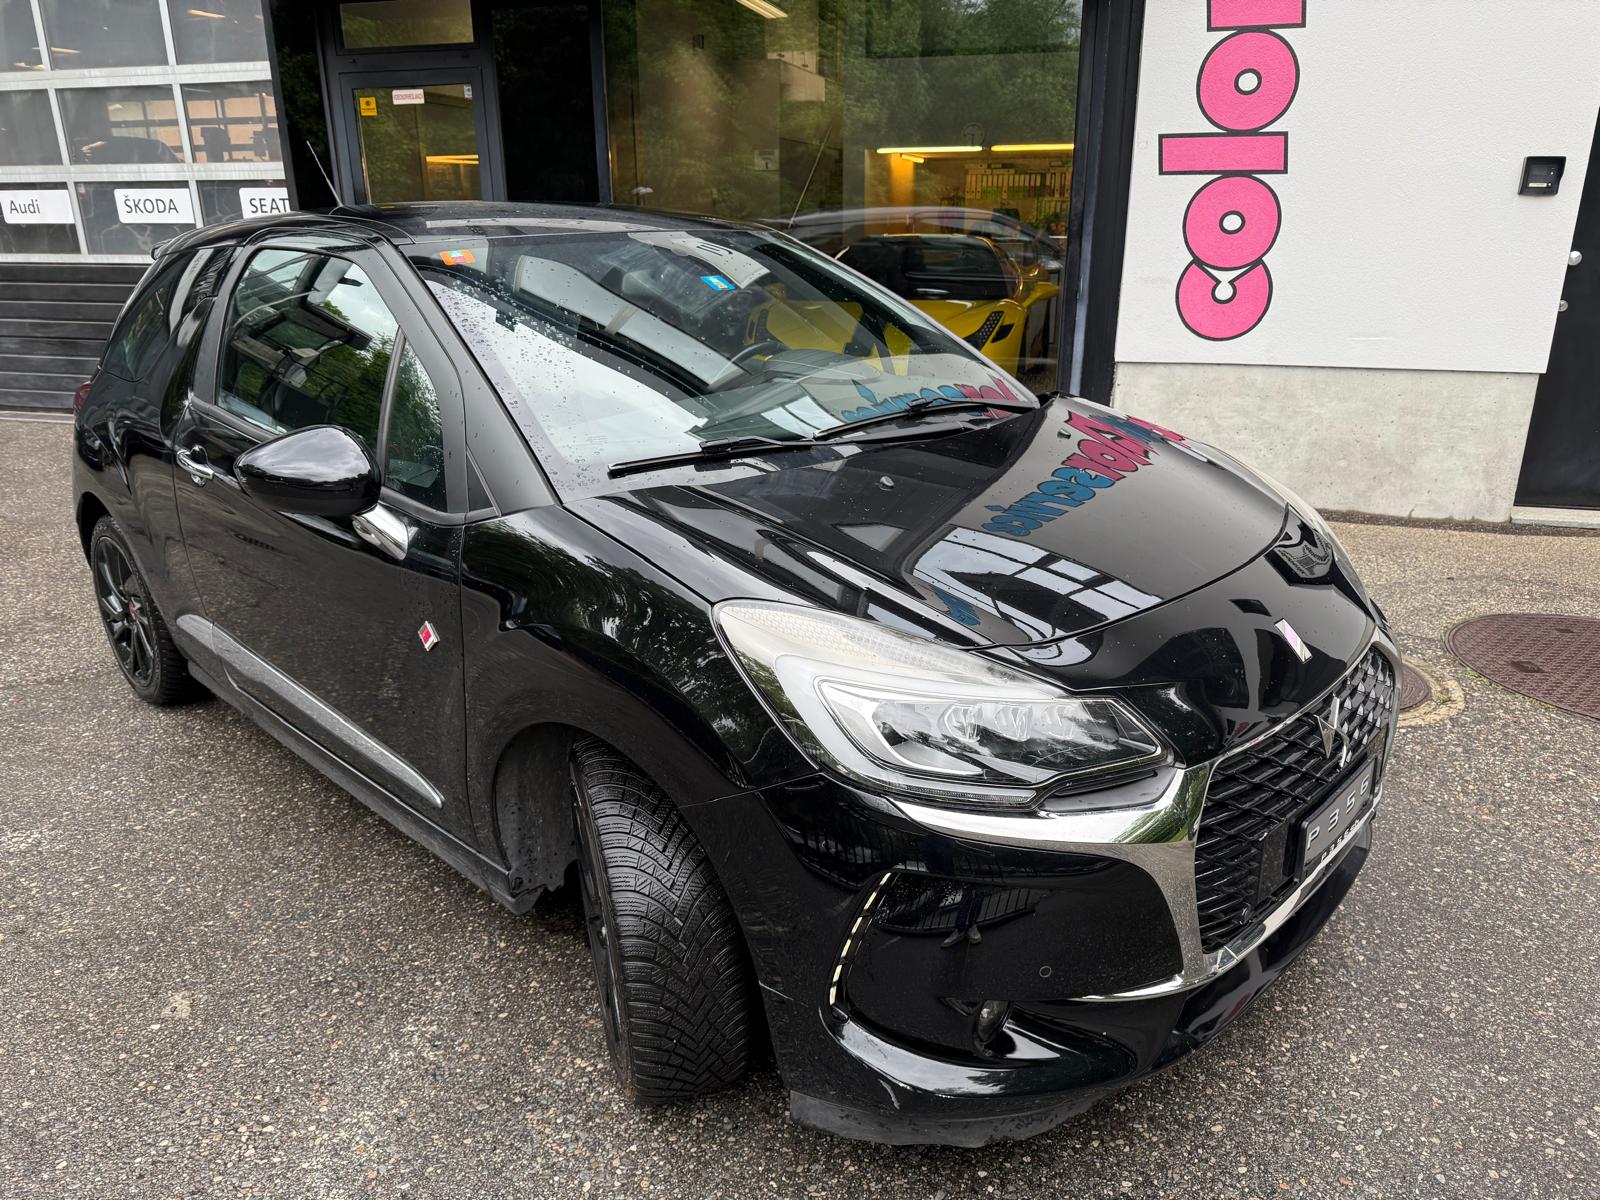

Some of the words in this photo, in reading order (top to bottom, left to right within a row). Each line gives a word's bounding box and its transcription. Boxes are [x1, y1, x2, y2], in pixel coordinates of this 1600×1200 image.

[9, 199, 41, 215] Audi
[123, 194, 179, 214] ŠKODA
[249, 198, 289, 214] SEAT
